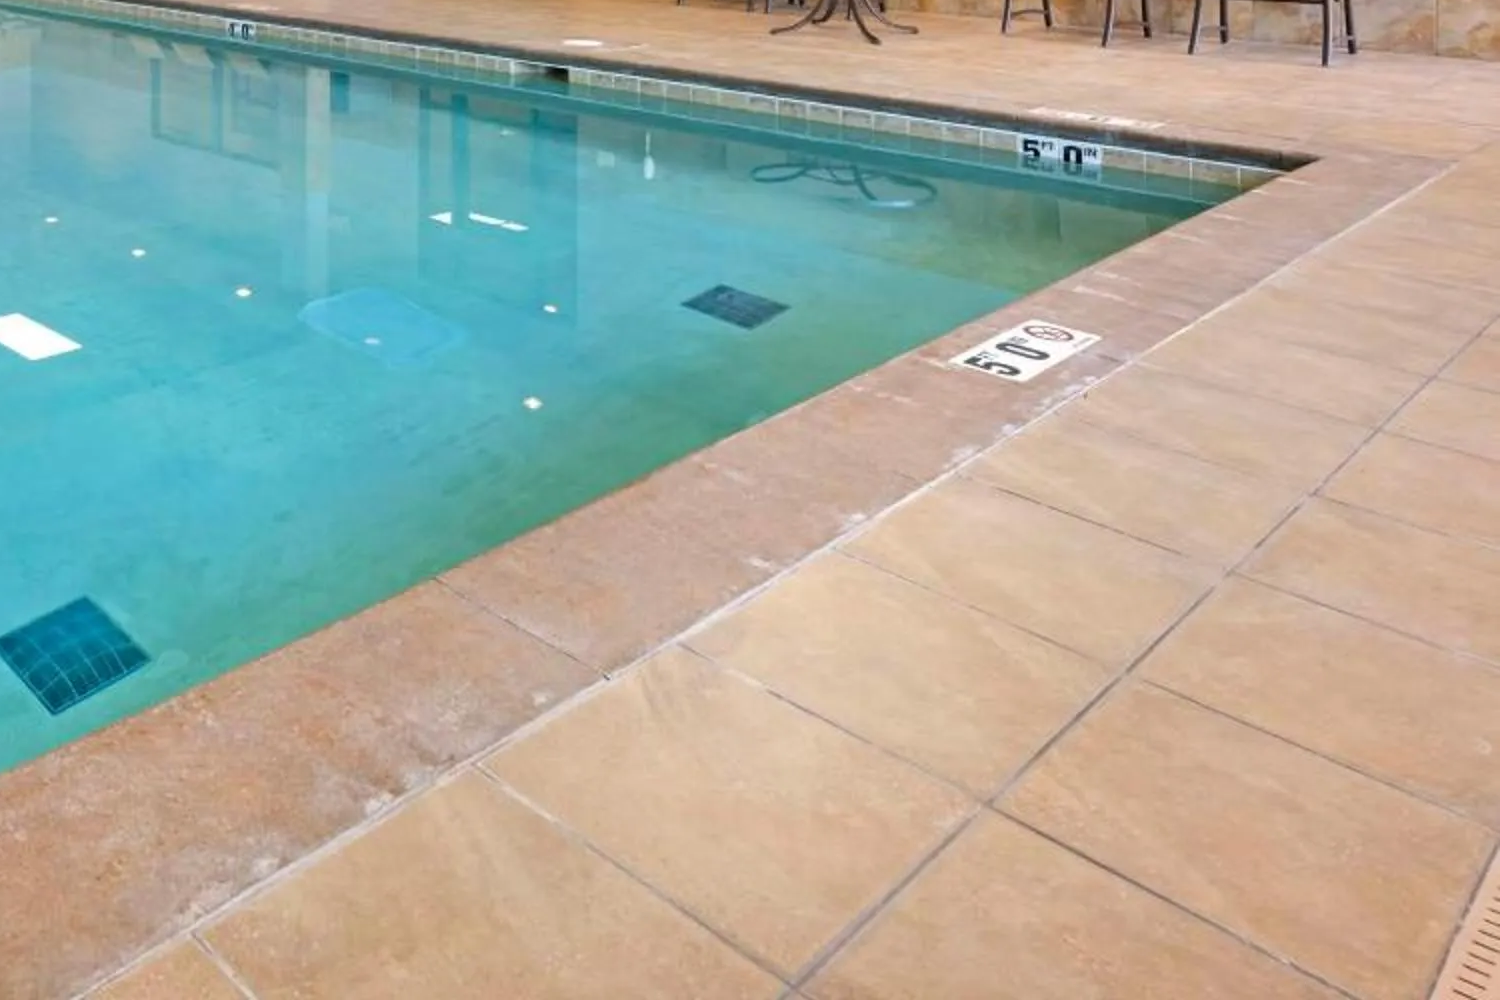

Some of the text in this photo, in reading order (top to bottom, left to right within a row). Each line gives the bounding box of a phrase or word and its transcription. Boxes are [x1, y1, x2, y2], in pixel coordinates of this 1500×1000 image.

[1023, 139, 1041, 158] 5
[1063, 145, 1083, 164] 0
[963, 355, 1022, 377] 5
[995, 341, 1051, 361] 0
